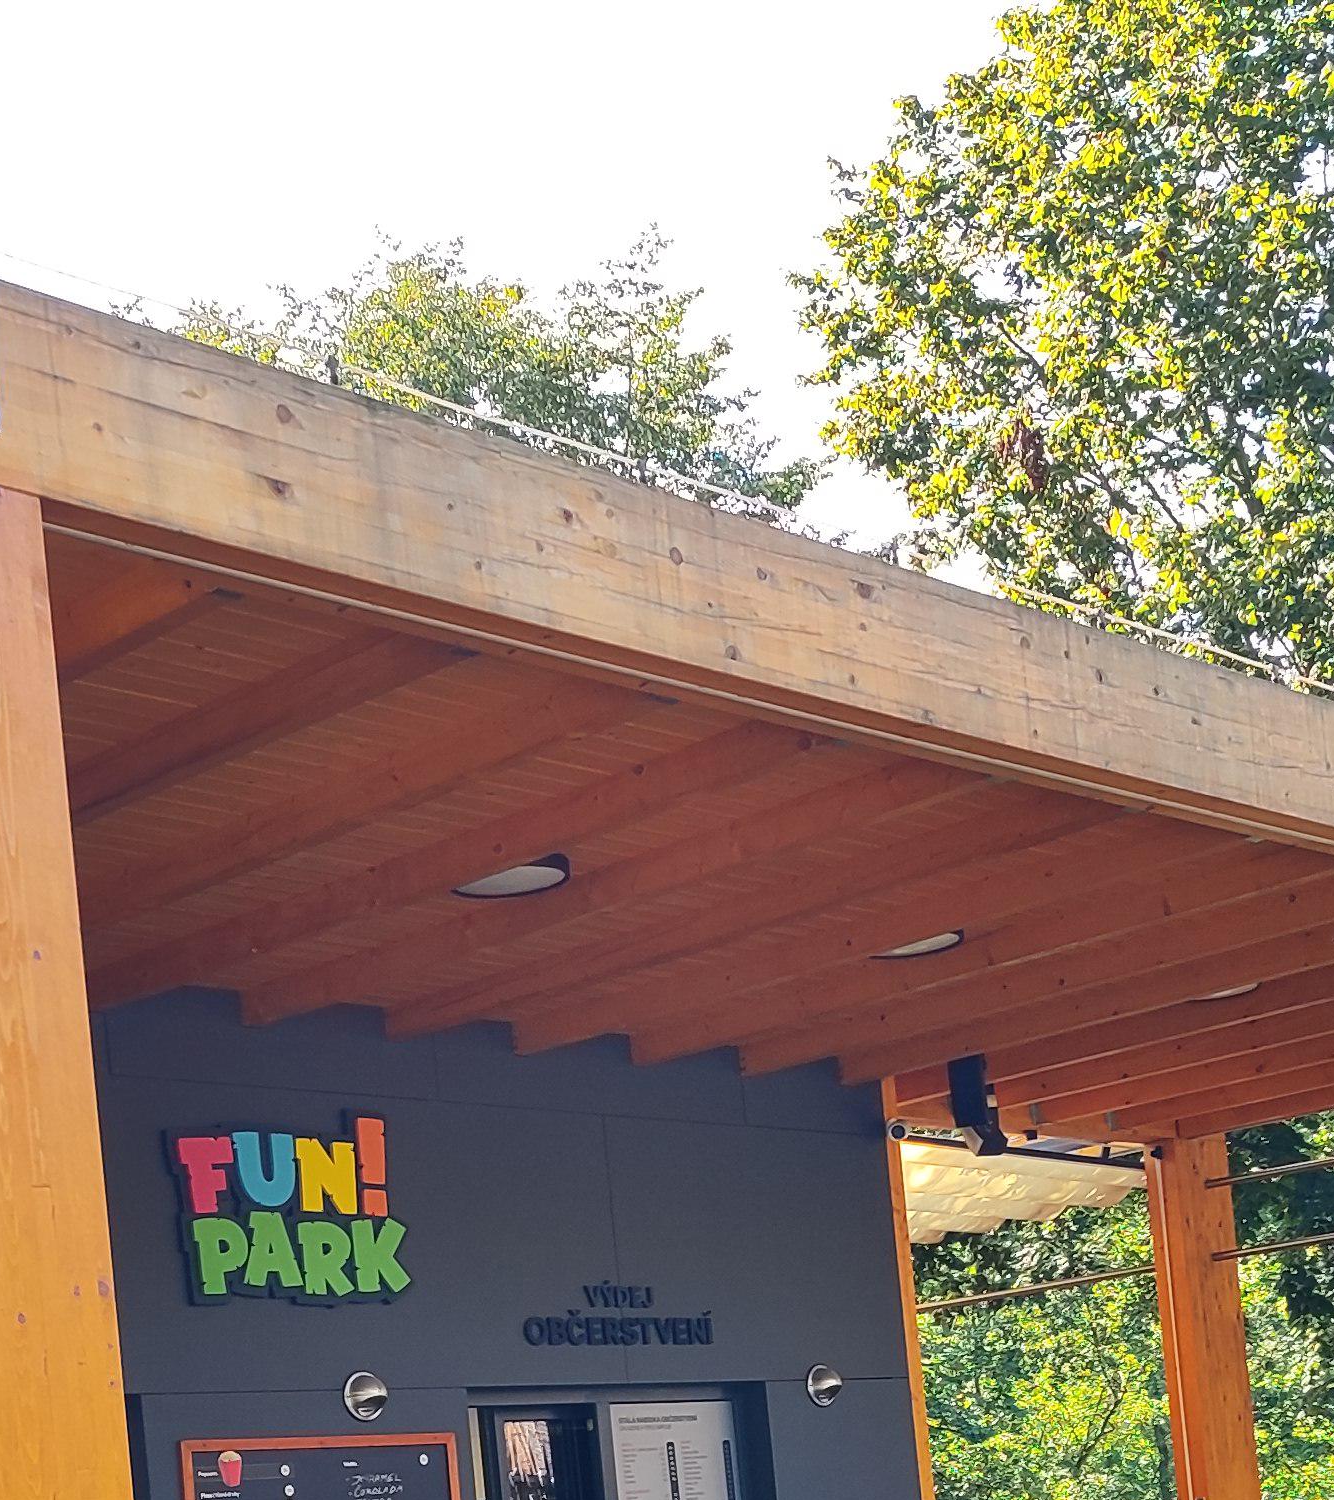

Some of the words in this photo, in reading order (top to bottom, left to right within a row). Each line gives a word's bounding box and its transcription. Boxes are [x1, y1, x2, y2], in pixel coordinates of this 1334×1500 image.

[177, 1117, 388, 1216] FUN!
[193, 1211, 411, 1297] PARK
[583, 1280, 654, 1309] VÝDEJ
[523, 1309, 714, 1346] OBČERSTVENÍ
